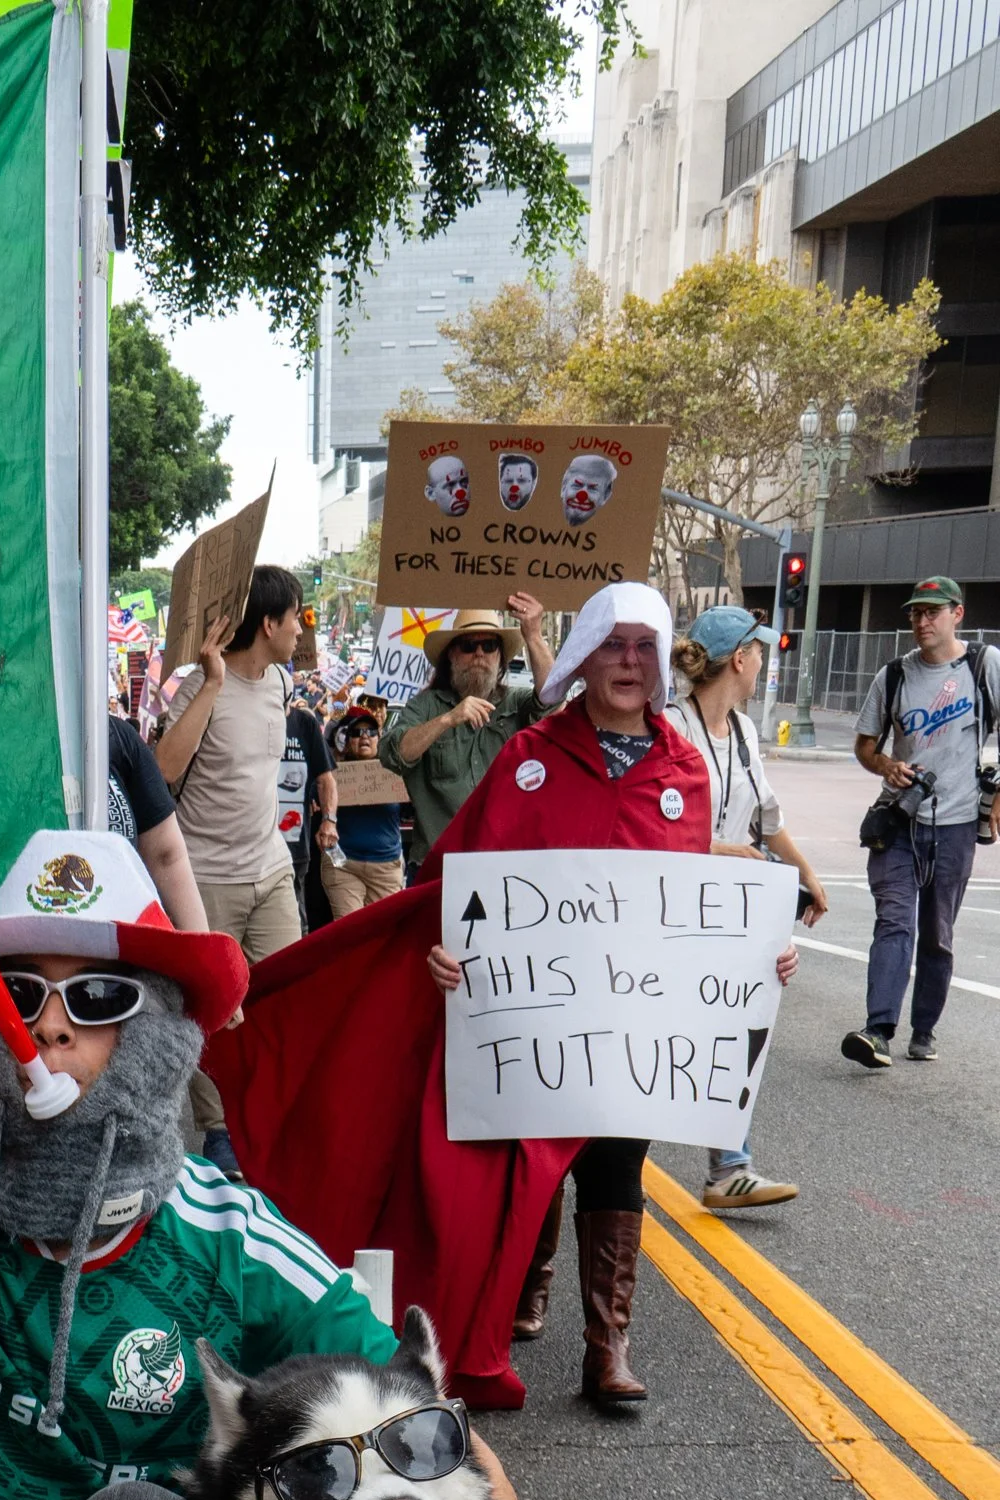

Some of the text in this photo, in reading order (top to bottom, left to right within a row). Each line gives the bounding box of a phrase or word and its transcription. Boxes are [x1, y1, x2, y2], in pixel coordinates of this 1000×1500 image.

[418, 436, 634, 467] BOZO DUMBO JUMBO
[430, 523, 598, 552] NO CROWNS
[394, 551, 625, 583] FOR THESE CLOWNS
[371, 645, 402, 677] NO
[402, 652, 431, 686] KIN
[901, 696, 973, 736] Dena
[288, 749, 305, 760] Hat.
[599, 740, 635, 768] NOPE
[665, 794, 679, 802] ICE
[665, 807, 681, 815] OUT
[503, 875, 765, 931] Don't LET
[458, 953, 765, 1008] THIS be our
[477, 1027, 769, 1111] FUTURE!
[109, 1392, 175, 1413] MÉXICO
